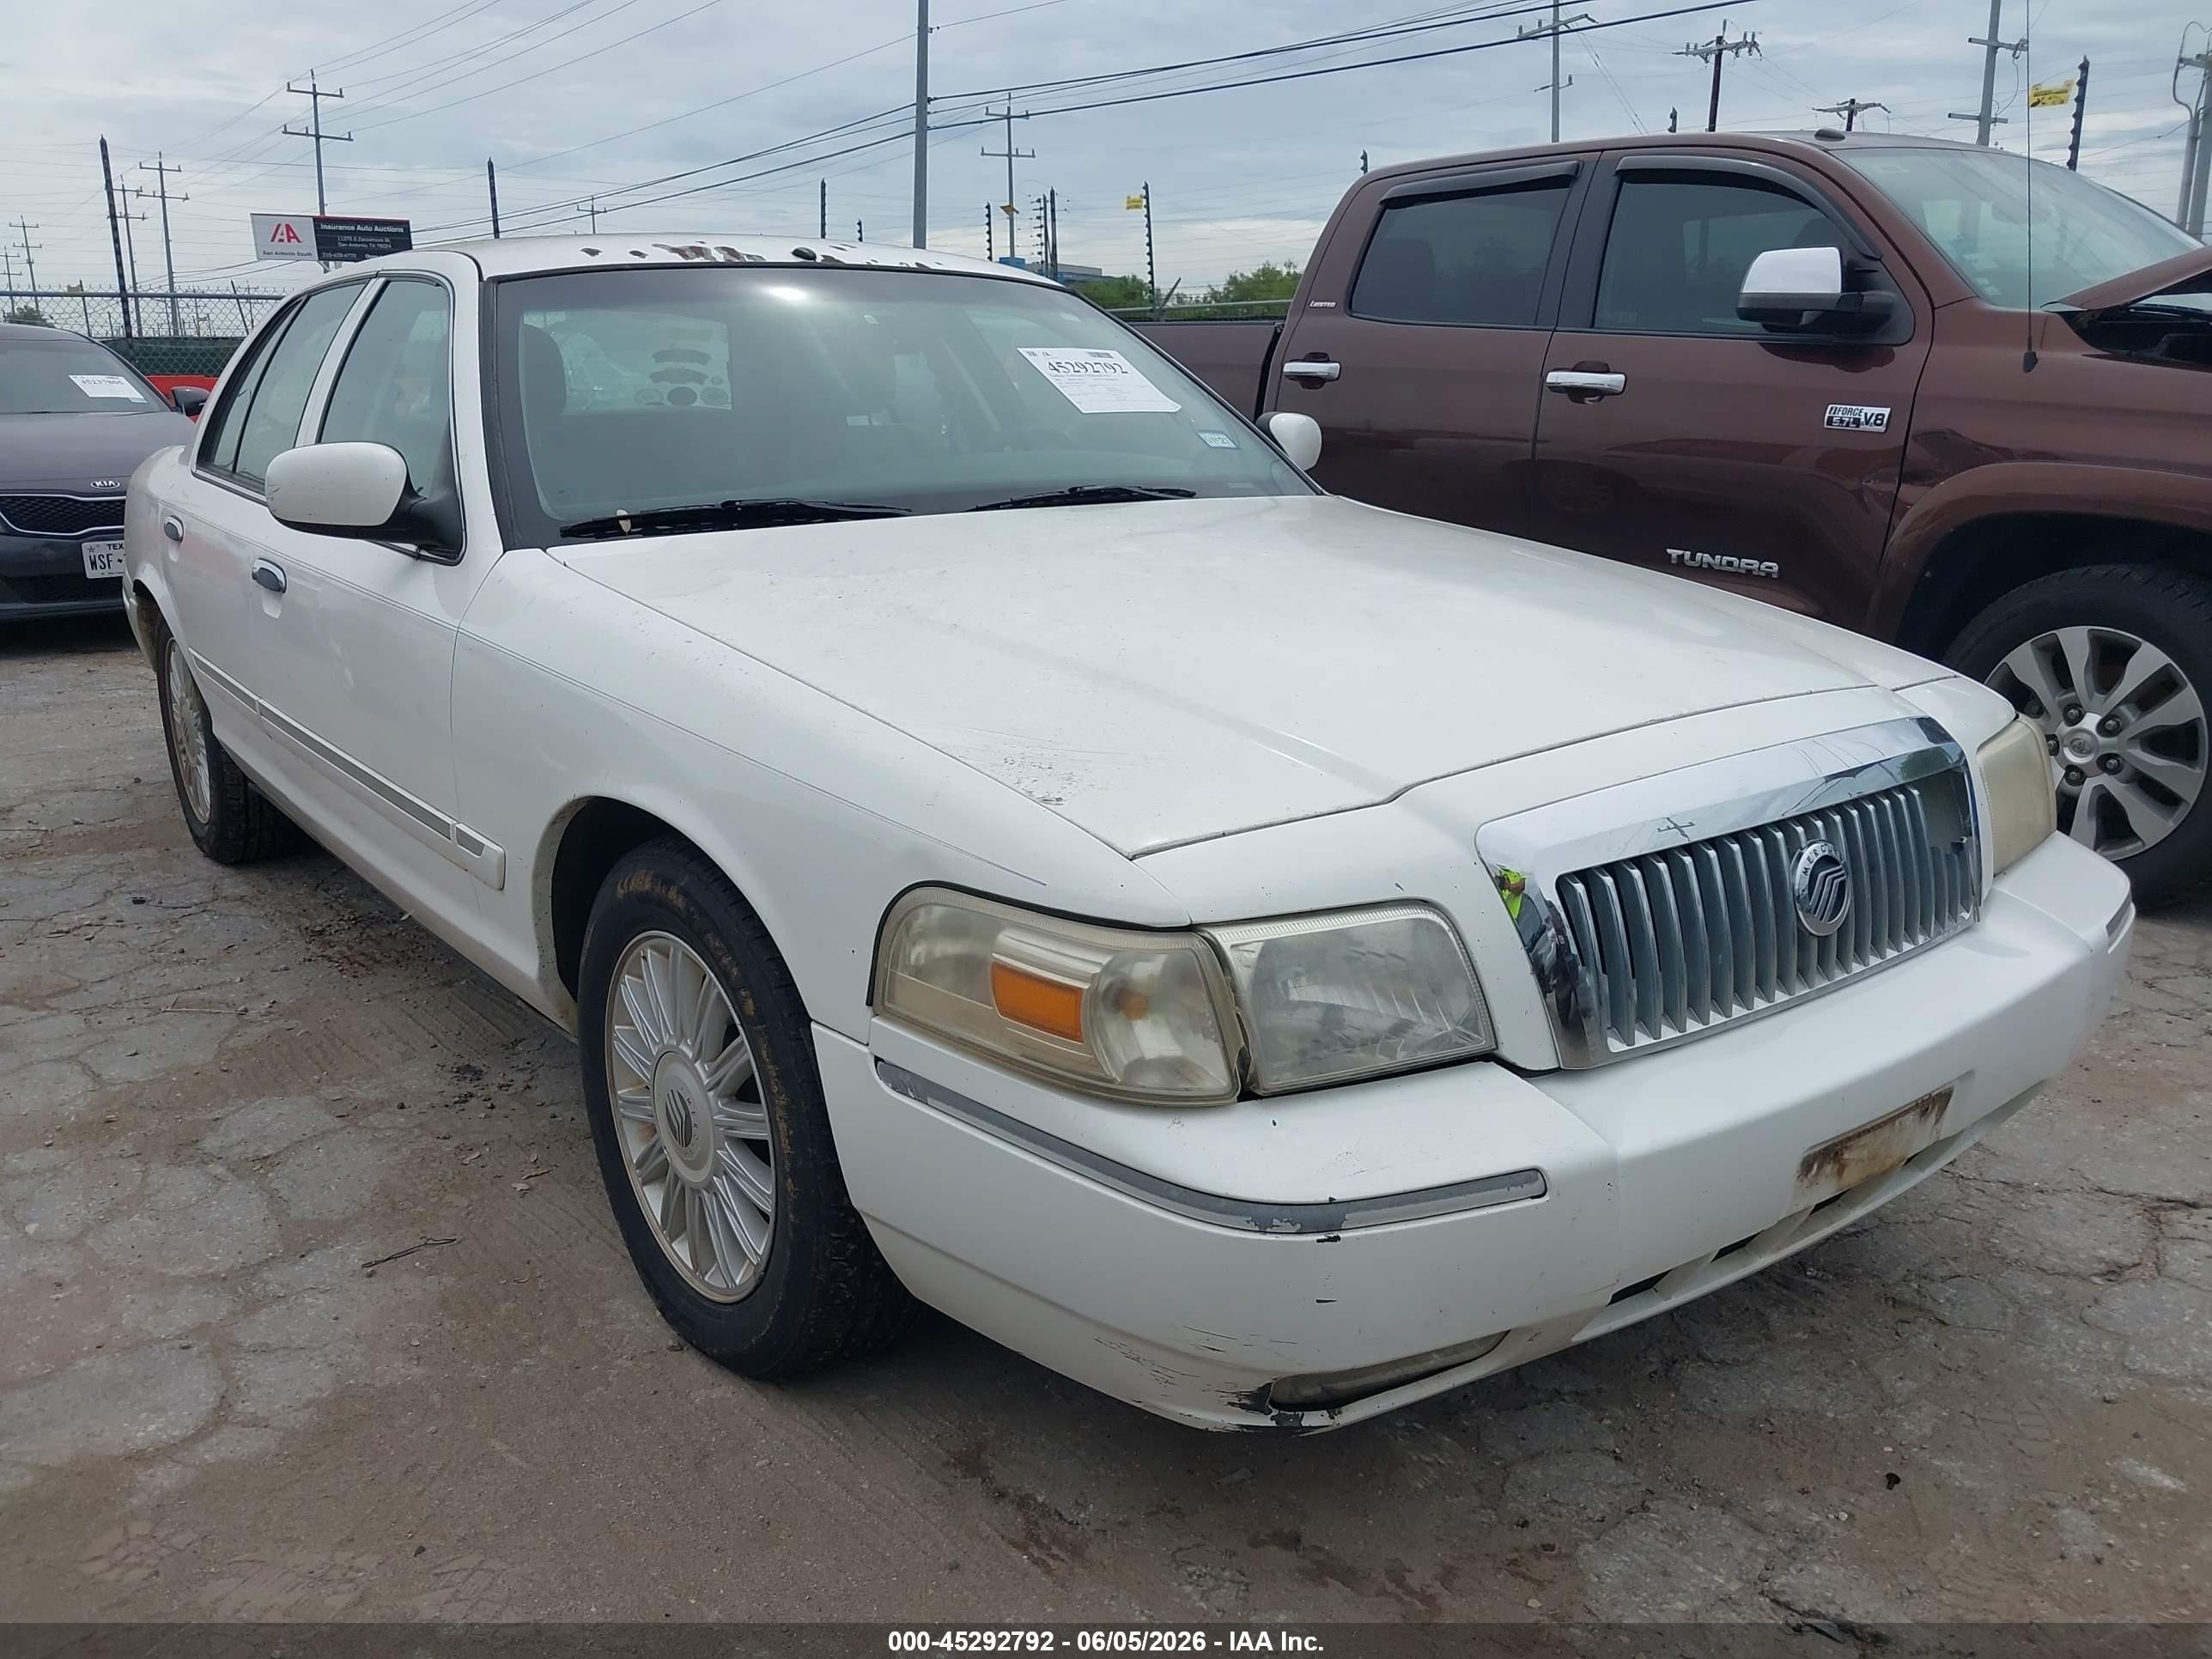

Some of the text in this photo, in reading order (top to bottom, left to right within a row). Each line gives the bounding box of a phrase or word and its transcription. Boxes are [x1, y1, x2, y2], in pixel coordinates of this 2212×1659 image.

[1048, 362, 1128, 374] 45292792
[1863, 411, 1886, 427] V8
[1666, 548, 1779, 579] TUNDRA
